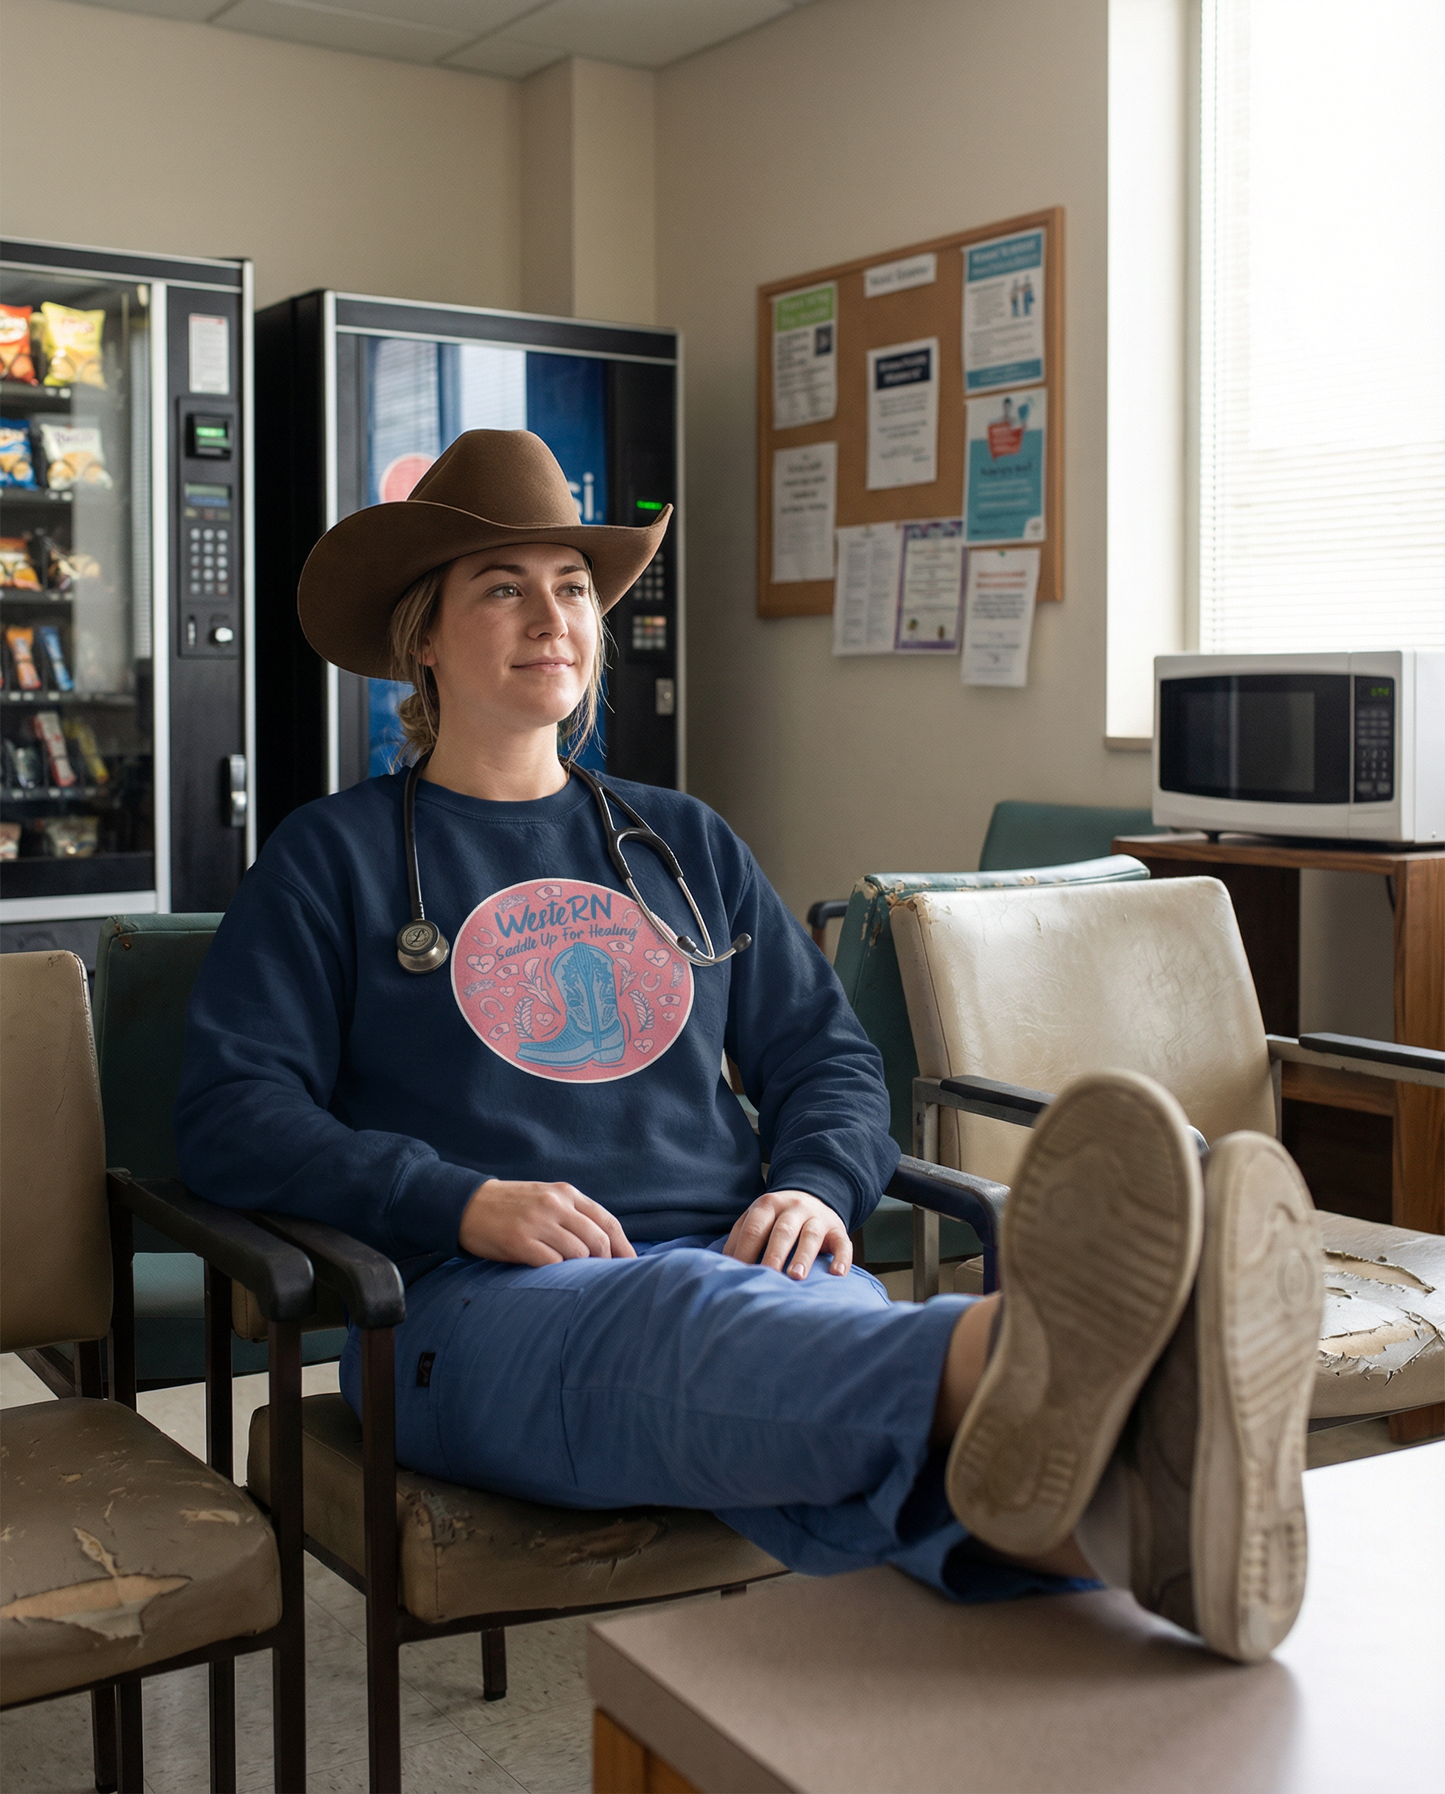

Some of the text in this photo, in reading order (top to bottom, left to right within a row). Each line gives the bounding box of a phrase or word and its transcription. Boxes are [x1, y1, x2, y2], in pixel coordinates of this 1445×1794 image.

[494, 893, 612, 938] WesteRN
[495, 923, 638, 961] Saddle Up For Healing
